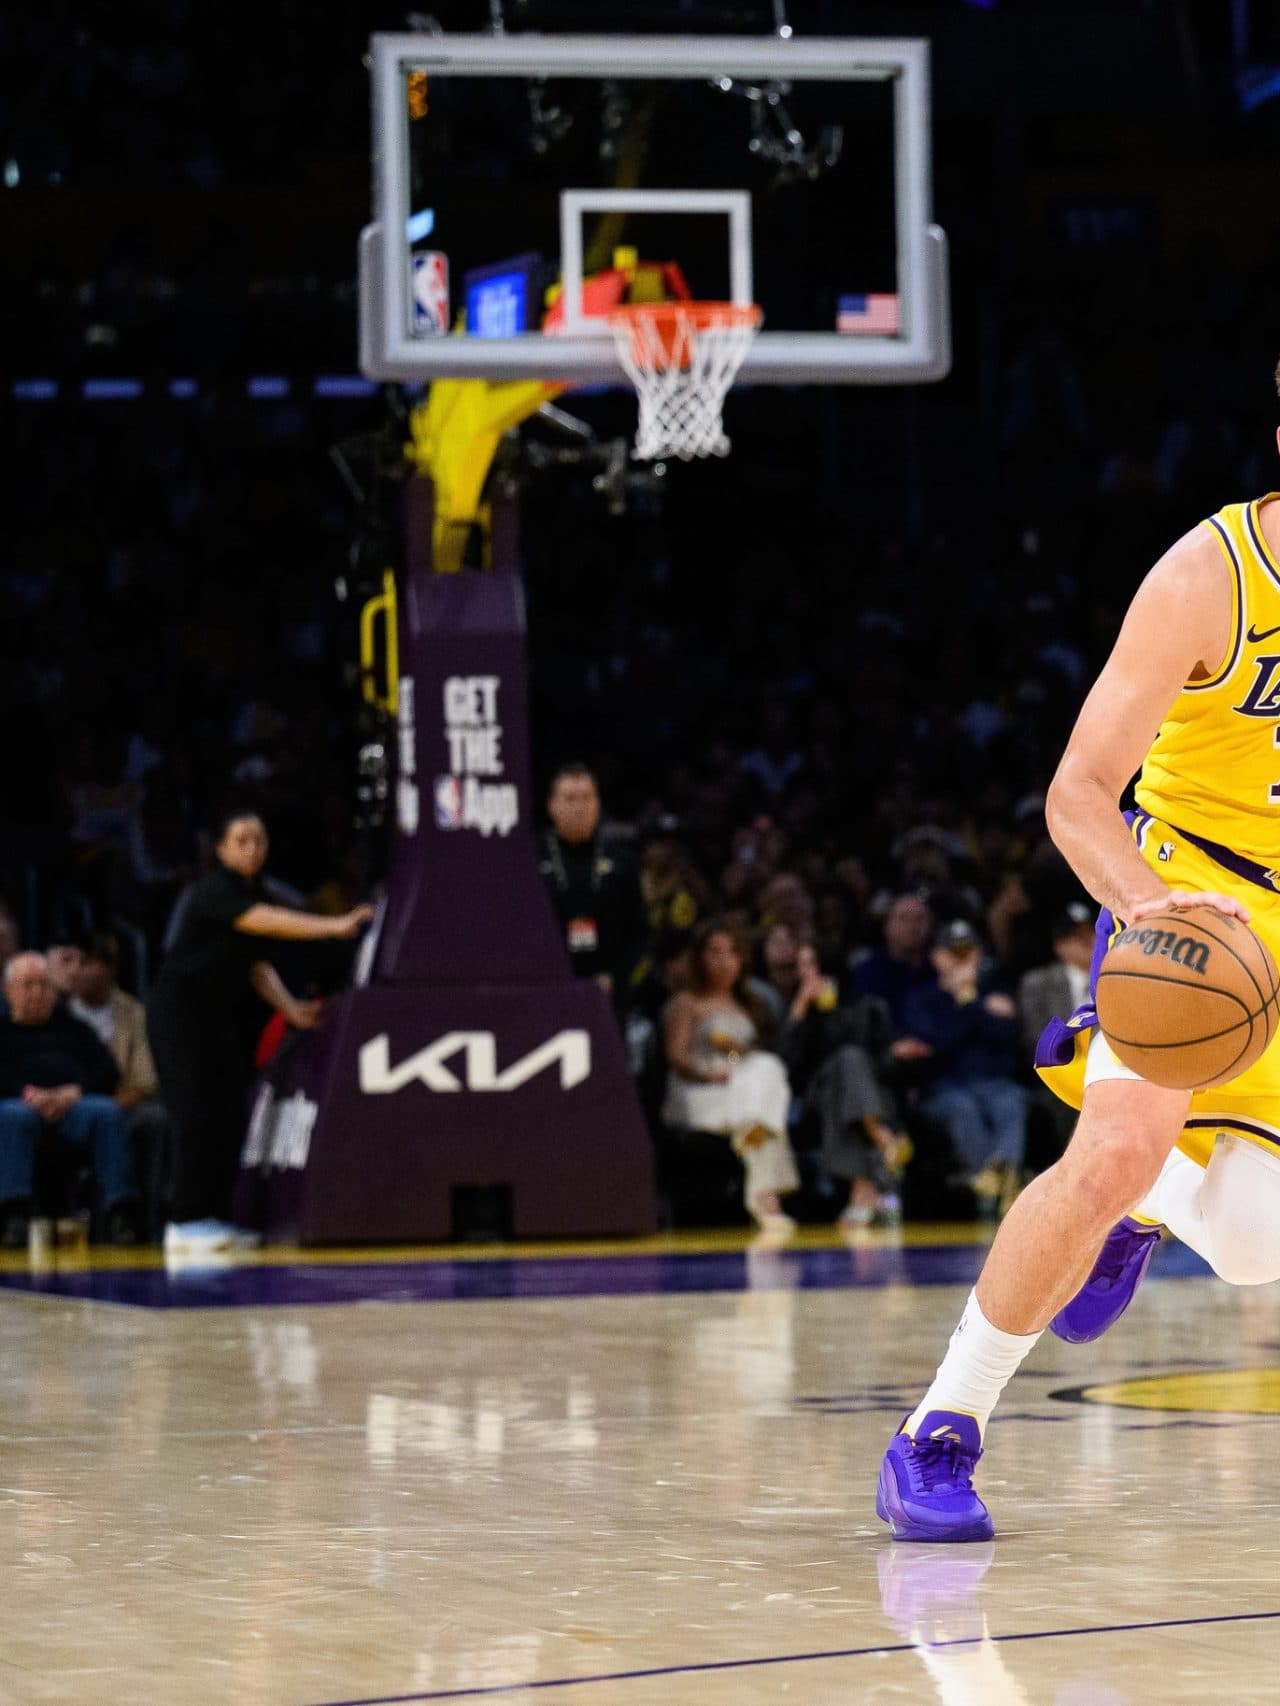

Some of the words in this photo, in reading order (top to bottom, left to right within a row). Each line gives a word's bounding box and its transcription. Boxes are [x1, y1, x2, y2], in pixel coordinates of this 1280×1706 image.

[443, 675, 500, 724] GET
[445, 725, 504, 776] THE
[358, 1029, 591, 1094] KIA
